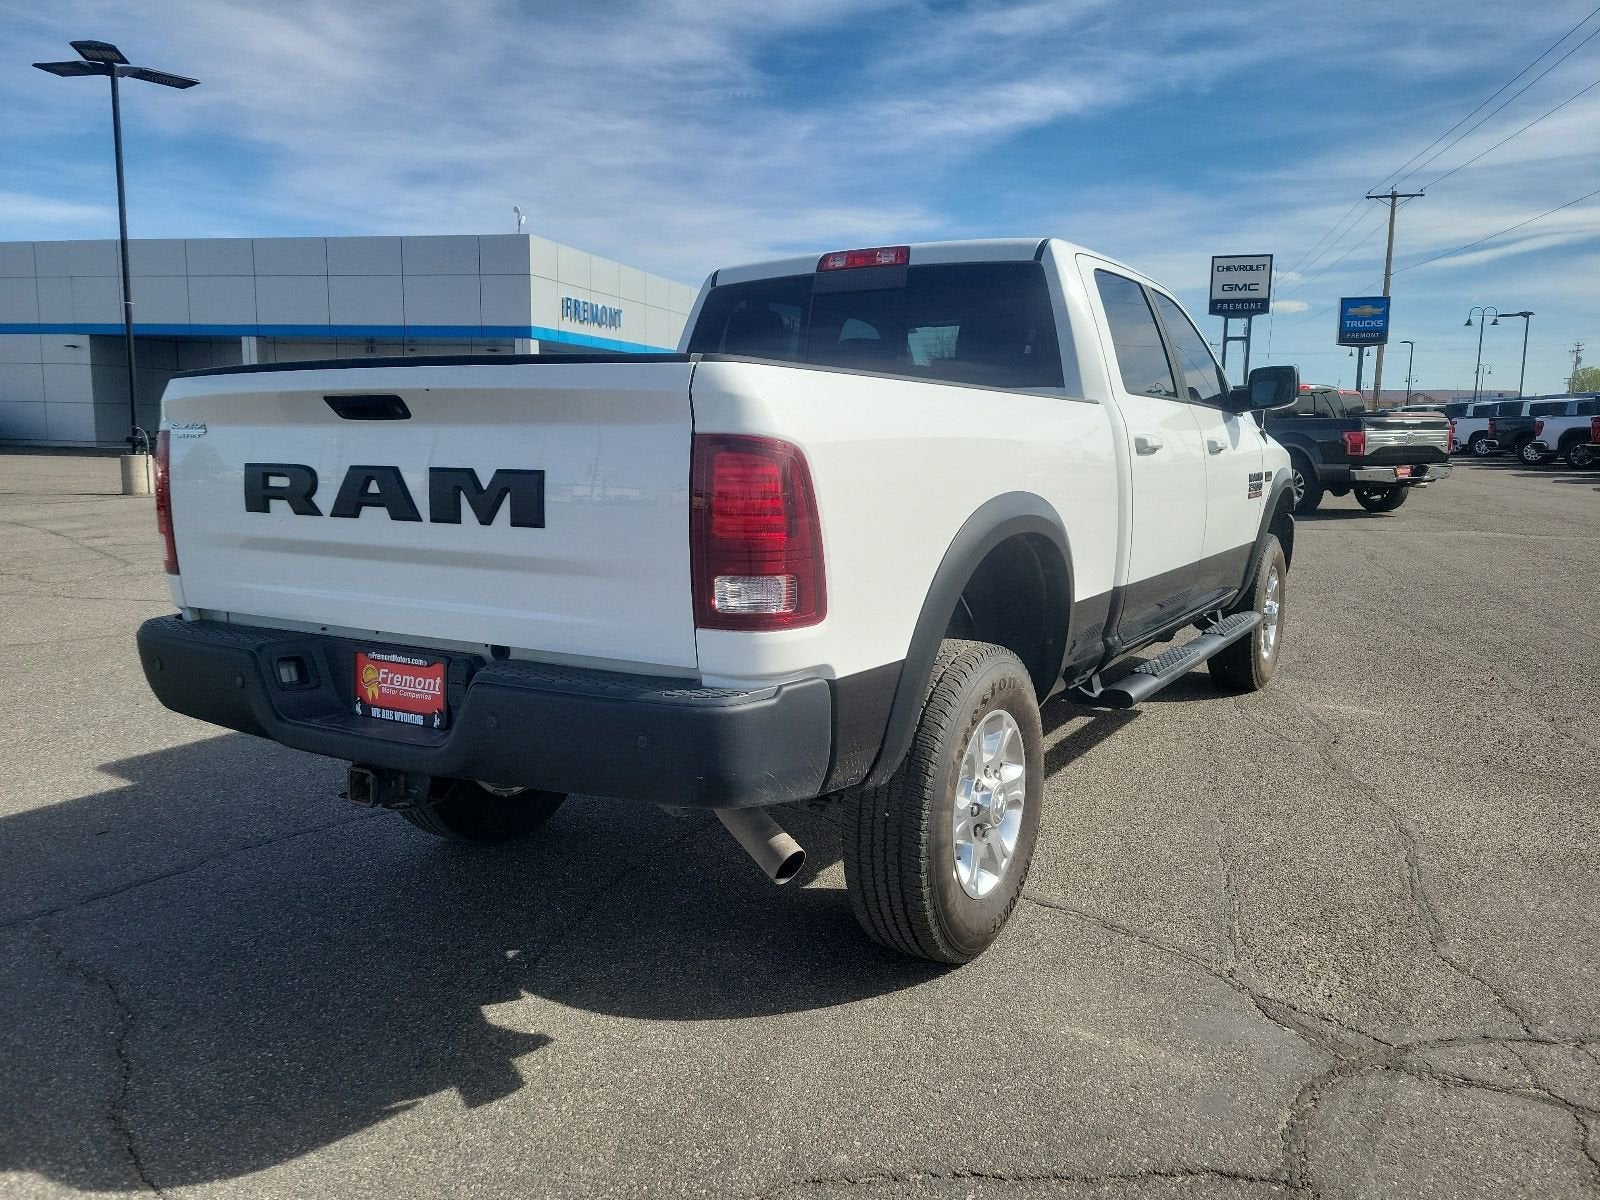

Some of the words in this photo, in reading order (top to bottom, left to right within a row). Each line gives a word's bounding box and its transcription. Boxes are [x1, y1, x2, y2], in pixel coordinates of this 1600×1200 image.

[1216, 264, 1268, 273] CHEVROLET
[1221, 283, 1260, 292] GMC
[562, 296, 623, 329] FREMONT
[1216, 302, 1263, 310] FREMONT
[1345, 319, 1384, 328] TRUCKS
[244, 462, 546, 529] RAM
[378, 668, 442, 692] Fremont
[381, 686, 398, 696] Motor
[399, 689, 432, 701] Companies
[371, 707, 382, 718] WE
[381, 709, 394, 721] ARE
[394, 711, 424, 726] WYOMING
